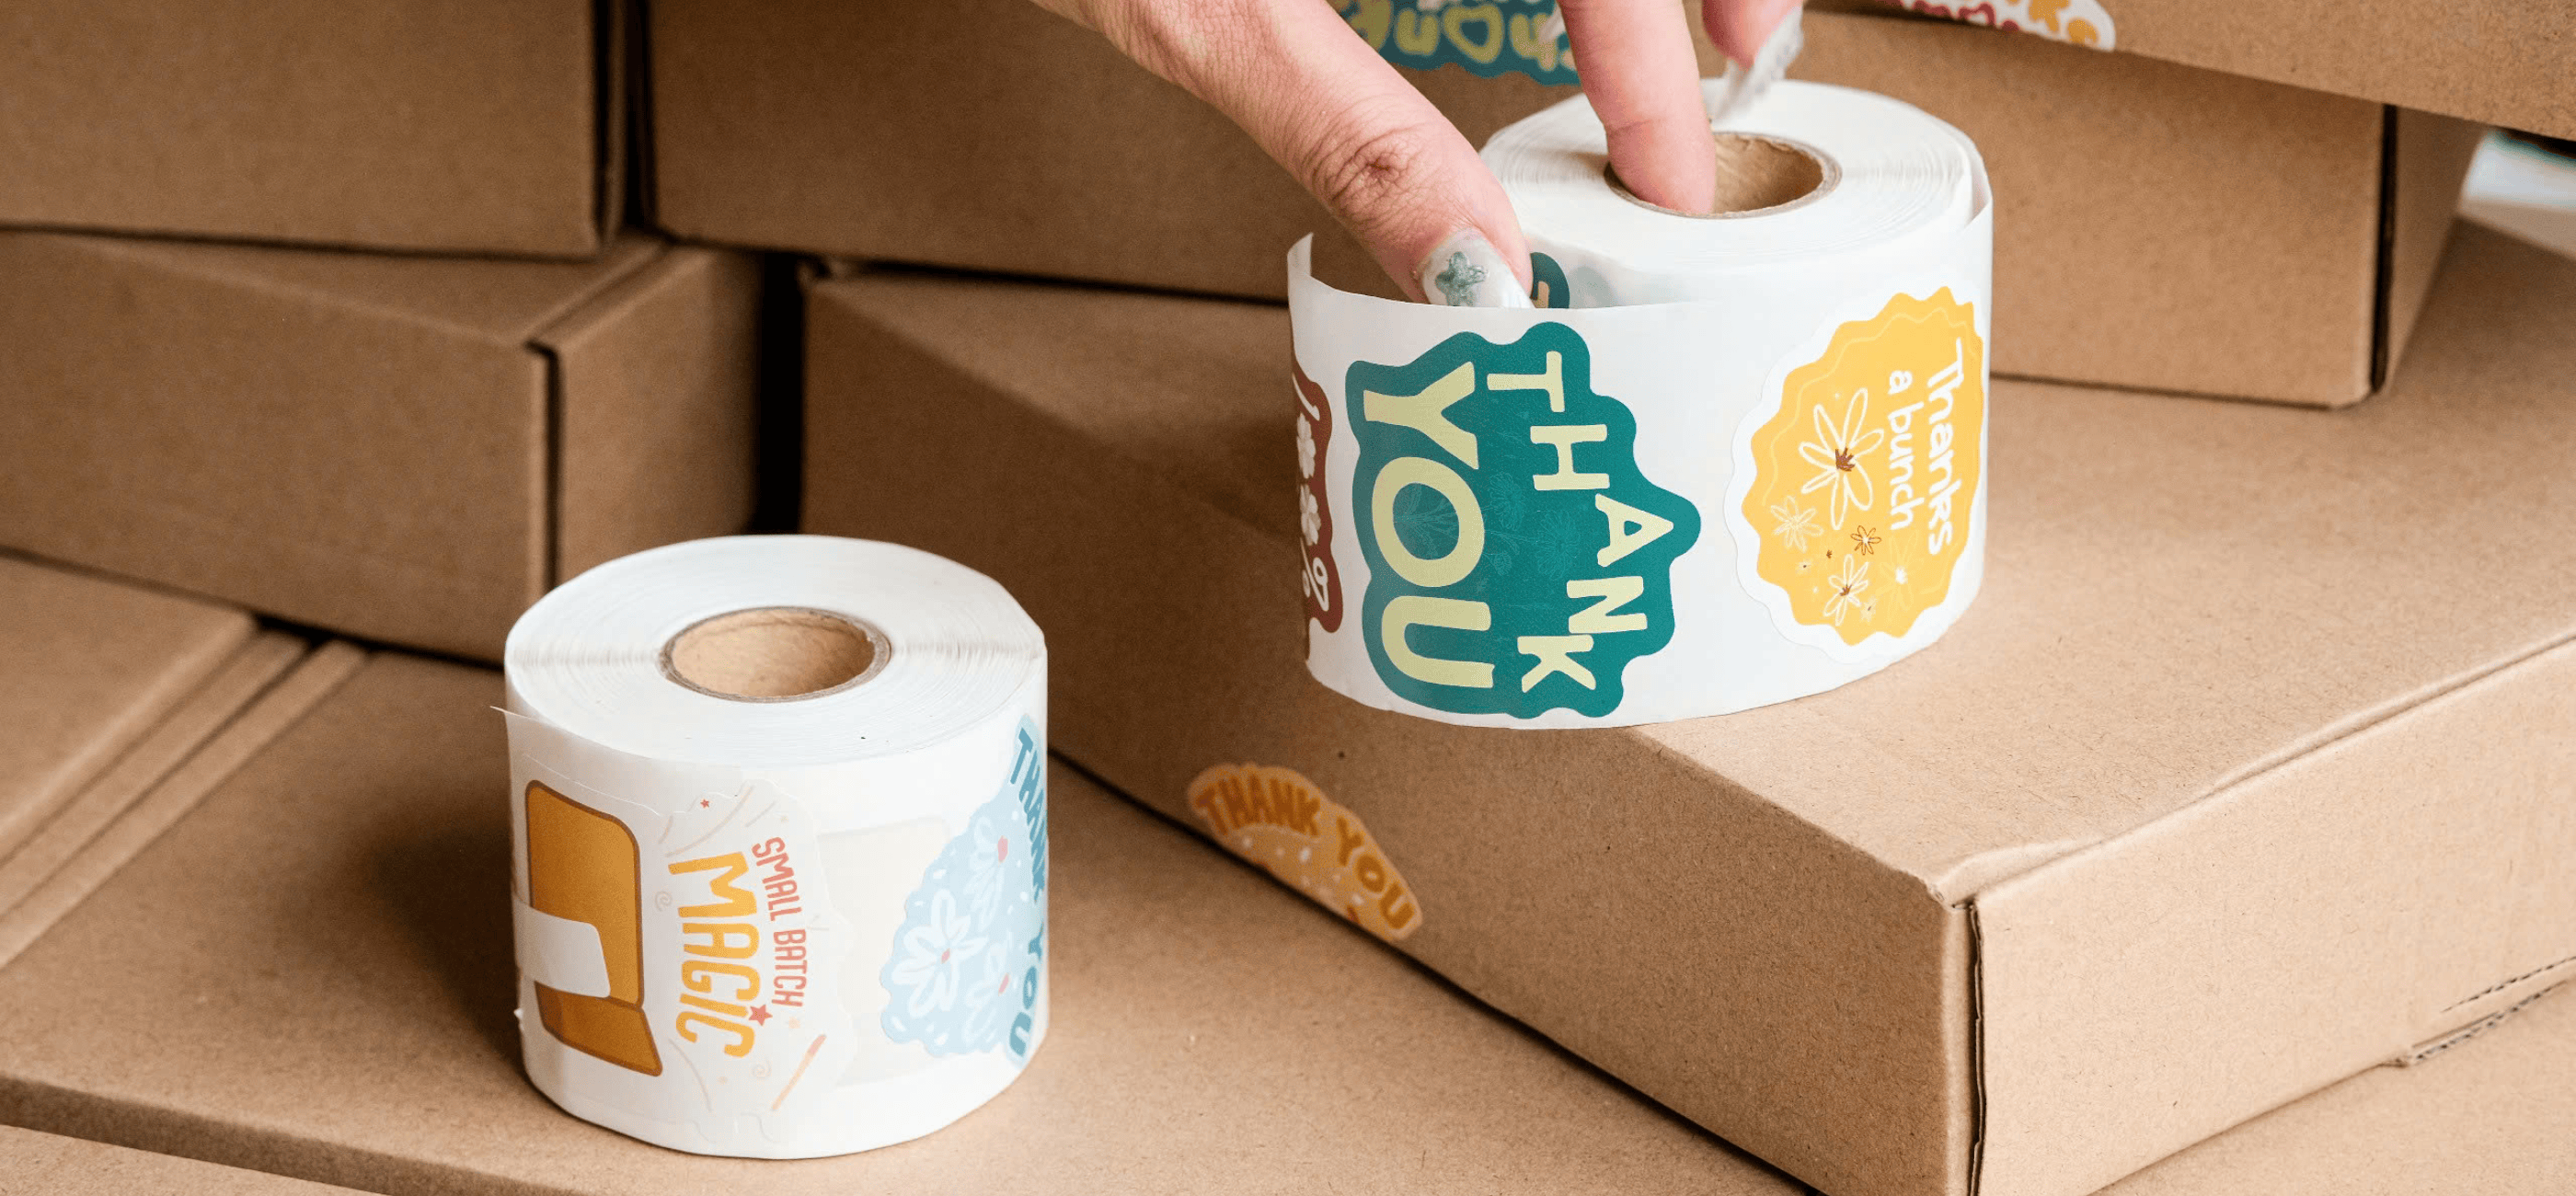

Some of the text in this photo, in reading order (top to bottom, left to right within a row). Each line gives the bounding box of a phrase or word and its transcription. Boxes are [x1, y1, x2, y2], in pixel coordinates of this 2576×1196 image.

[1363, 361, 1496, 690] YOU
[1486, 351, 1674, 694] THANK
[1887, 369, 1926, 531] a bunch
[1926, 336, 1965, 556] Thanks
[750, 835, 809, 1007] SMALL BATCH
[1195, 773, 1415, 930] THANK YOU
